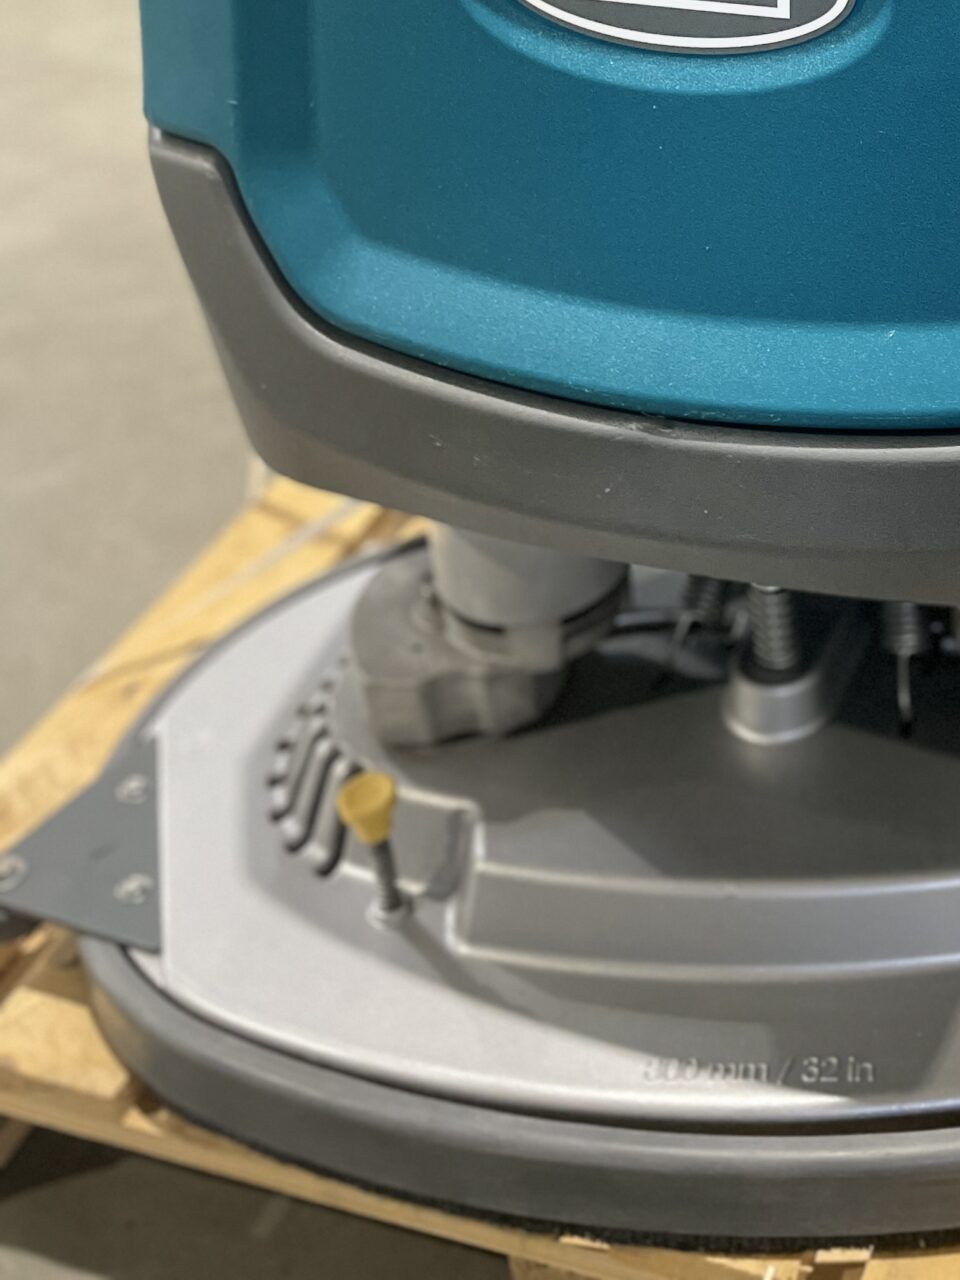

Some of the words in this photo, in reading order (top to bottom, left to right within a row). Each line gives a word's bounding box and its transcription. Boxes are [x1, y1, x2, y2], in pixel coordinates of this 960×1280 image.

[706, 1061, 768, 1082] mm
[775, 1055, 794, 1087] /
[800, 1056, 839, 1083] 32
[845, 1056, 875, 1083] in
